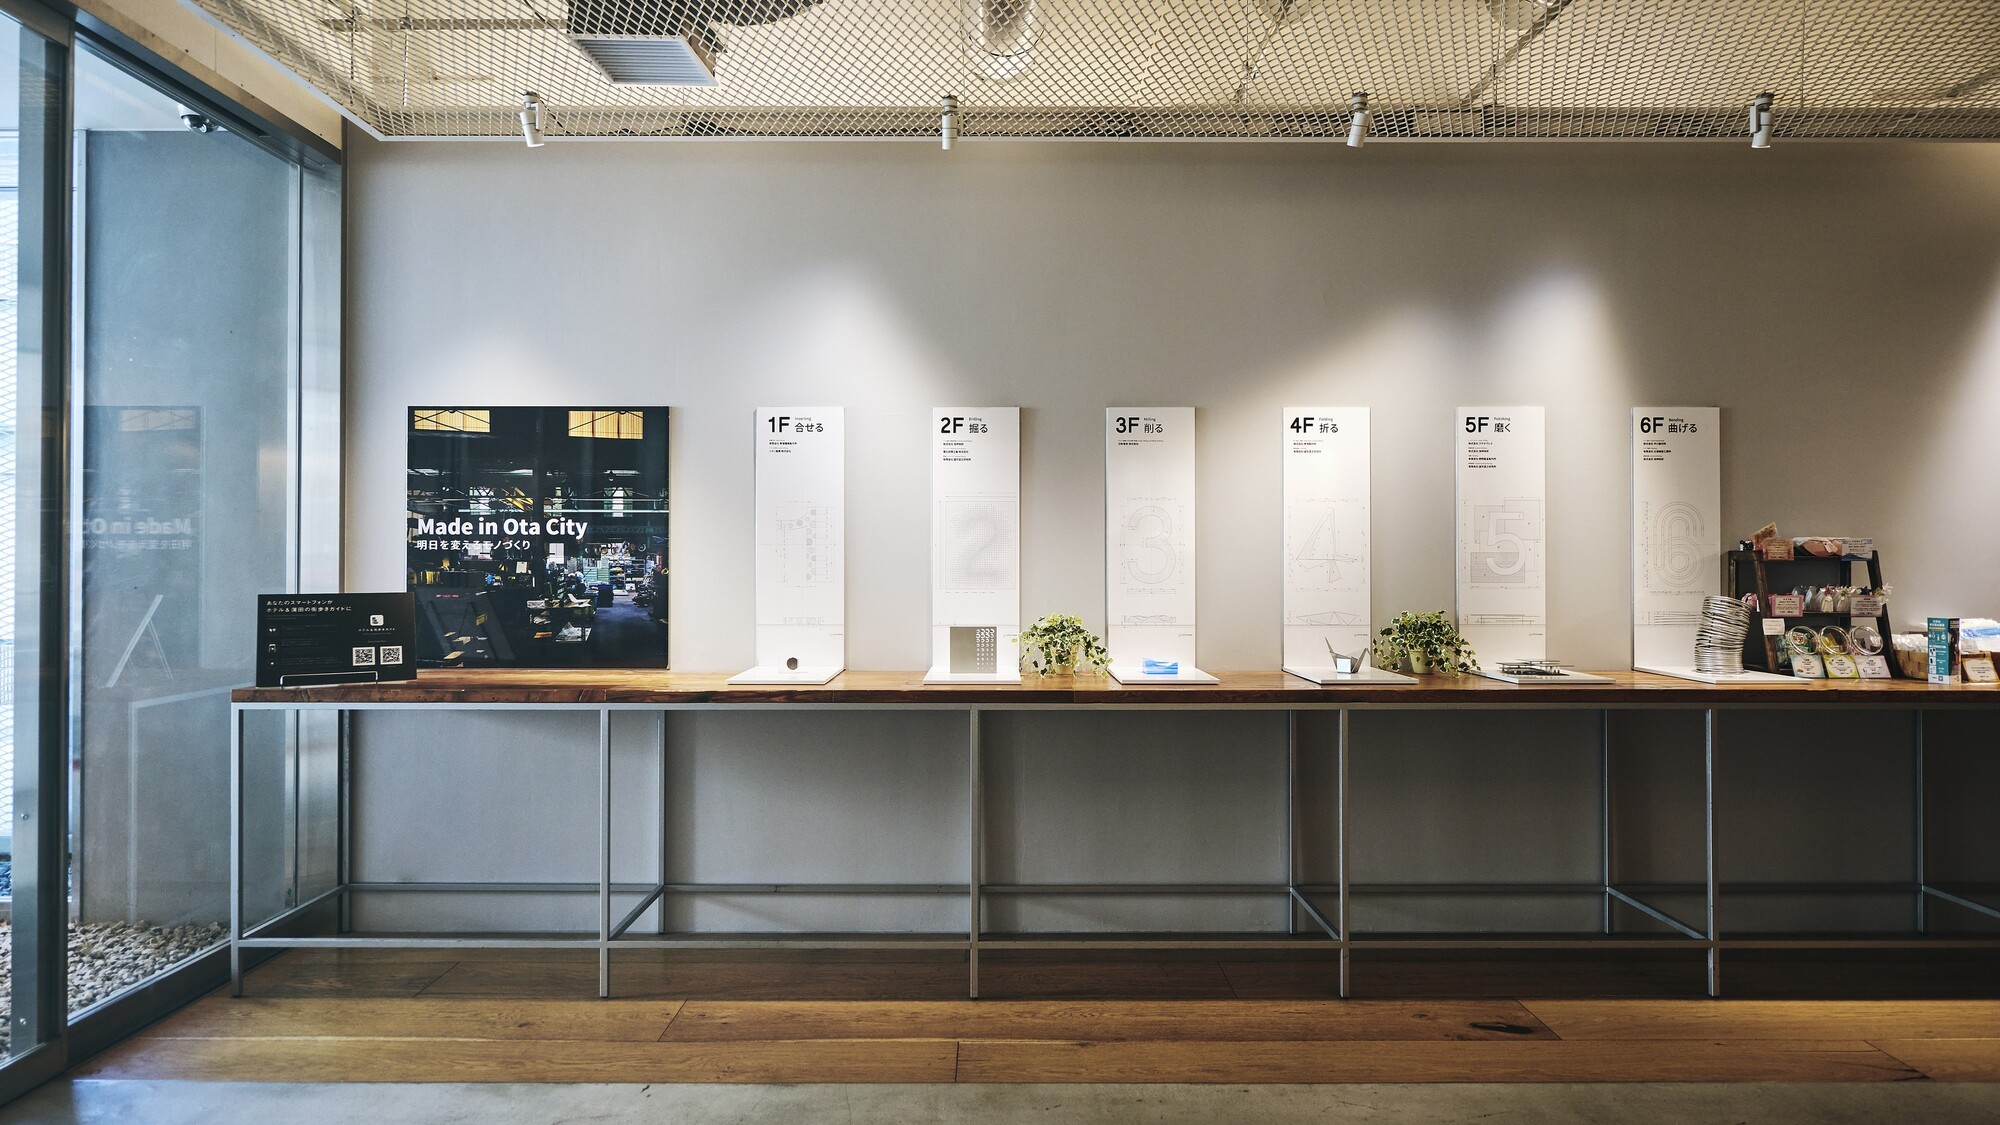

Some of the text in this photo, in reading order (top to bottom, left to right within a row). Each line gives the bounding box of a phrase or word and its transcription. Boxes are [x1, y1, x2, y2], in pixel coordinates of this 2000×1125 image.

[768, 416, 791, 433] 1F
[795, 422, 824, 433] 合せる
[941, 417, 965, 434] 2F
[969, 423, 989, 434] 掘る
[1116, 417, 1140, 434] 3F
[1144, 423, 1164, 434] 削る
[1290, 417, 1315, 434] 4F
[1319, 423, 1339, 434] 折る
[1465, 416, 1489, 433] 5F
[1494, 422, 1511, 433] 磨く
[1640, 417, 1665, 434] 6F
[1668, 423, 1698, 434] 曲げる
[418, 517, 588, 540] Made in Ota City
[417, 540, 531, 550] 明日を変えるモノづくり
[1127, 506, 1176, 584] 3
[1485, 511, 1528, 576] 5
[1653, 501, 1704, 587] 6
